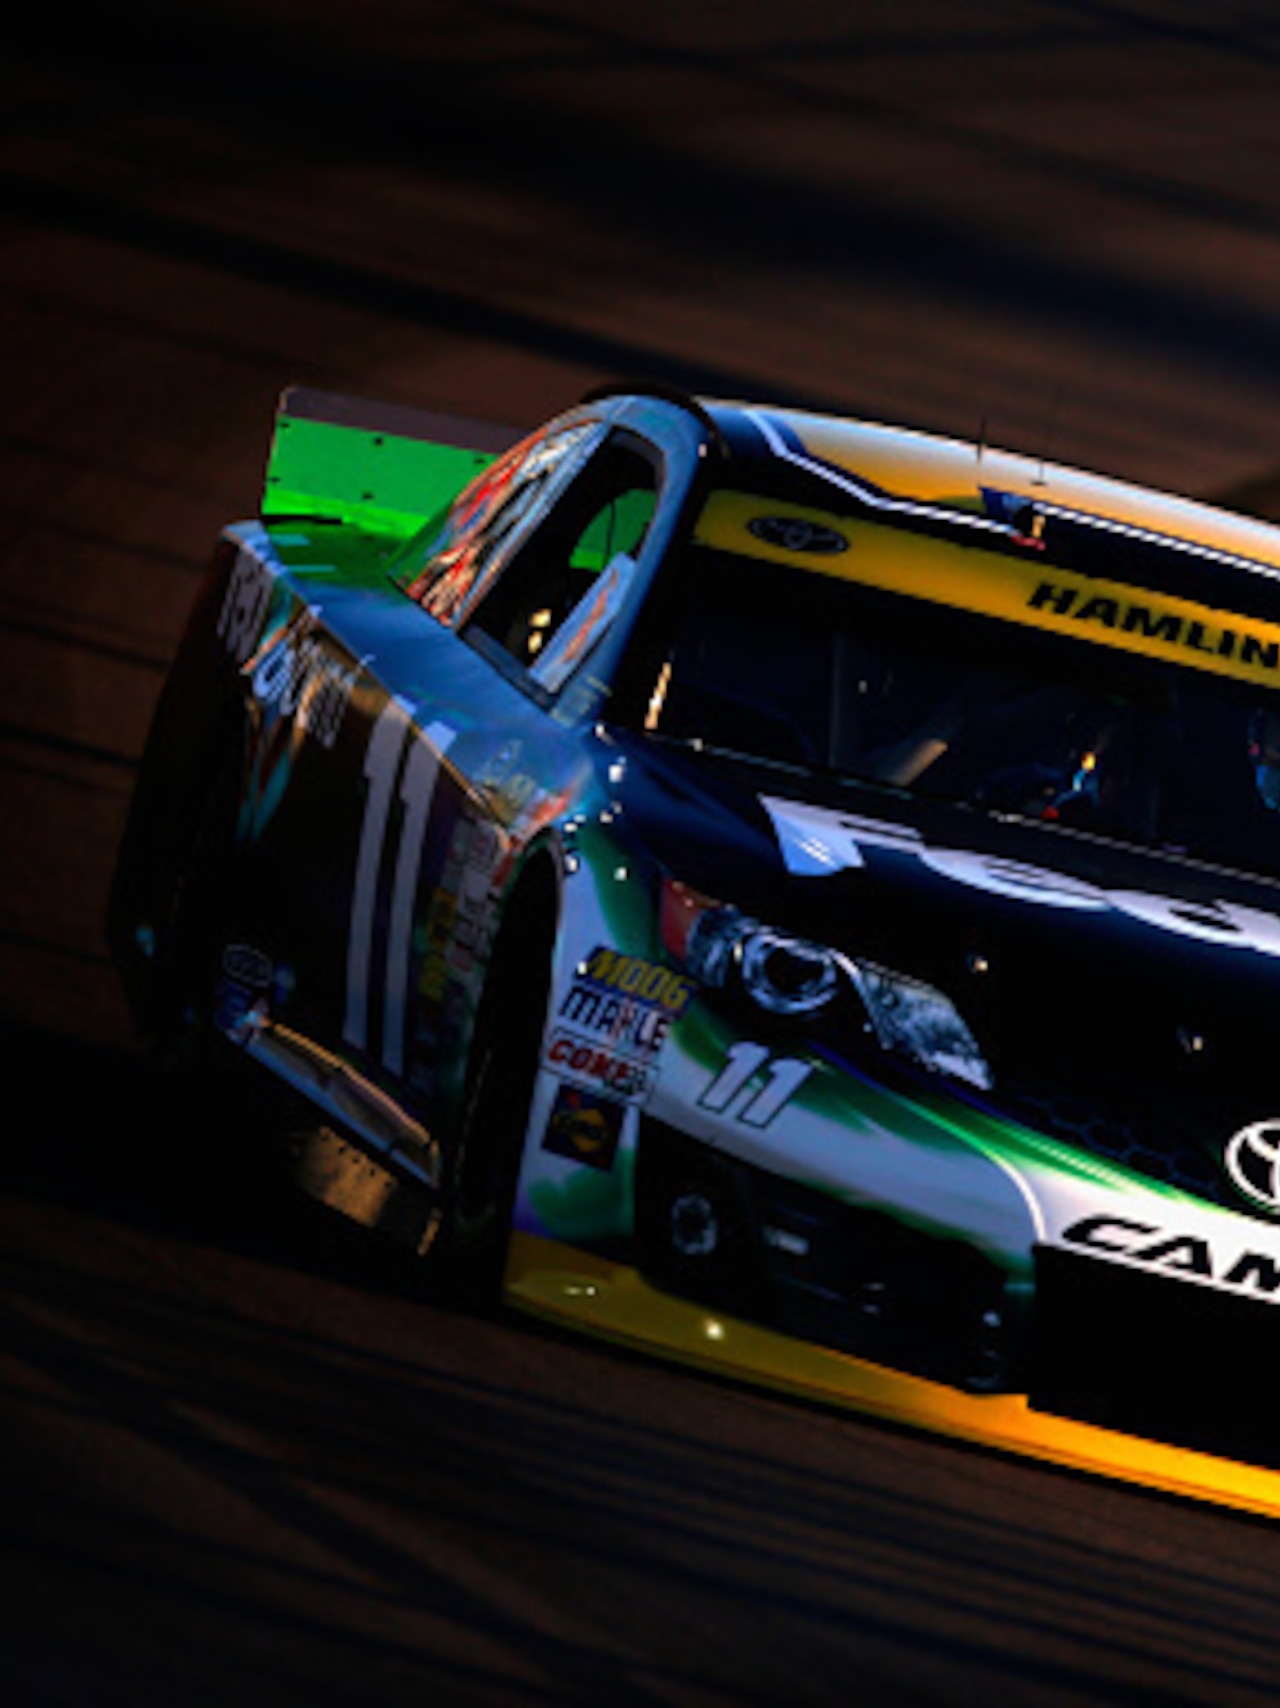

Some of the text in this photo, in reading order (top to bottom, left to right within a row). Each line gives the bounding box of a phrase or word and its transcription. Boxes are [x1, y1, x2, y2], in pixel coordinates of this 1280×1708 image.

[1029, 582, 1280, 669] HAMLIN
[590, 950, 698, 1010] MOOG
[697, 1038, 815, 1129] 11
